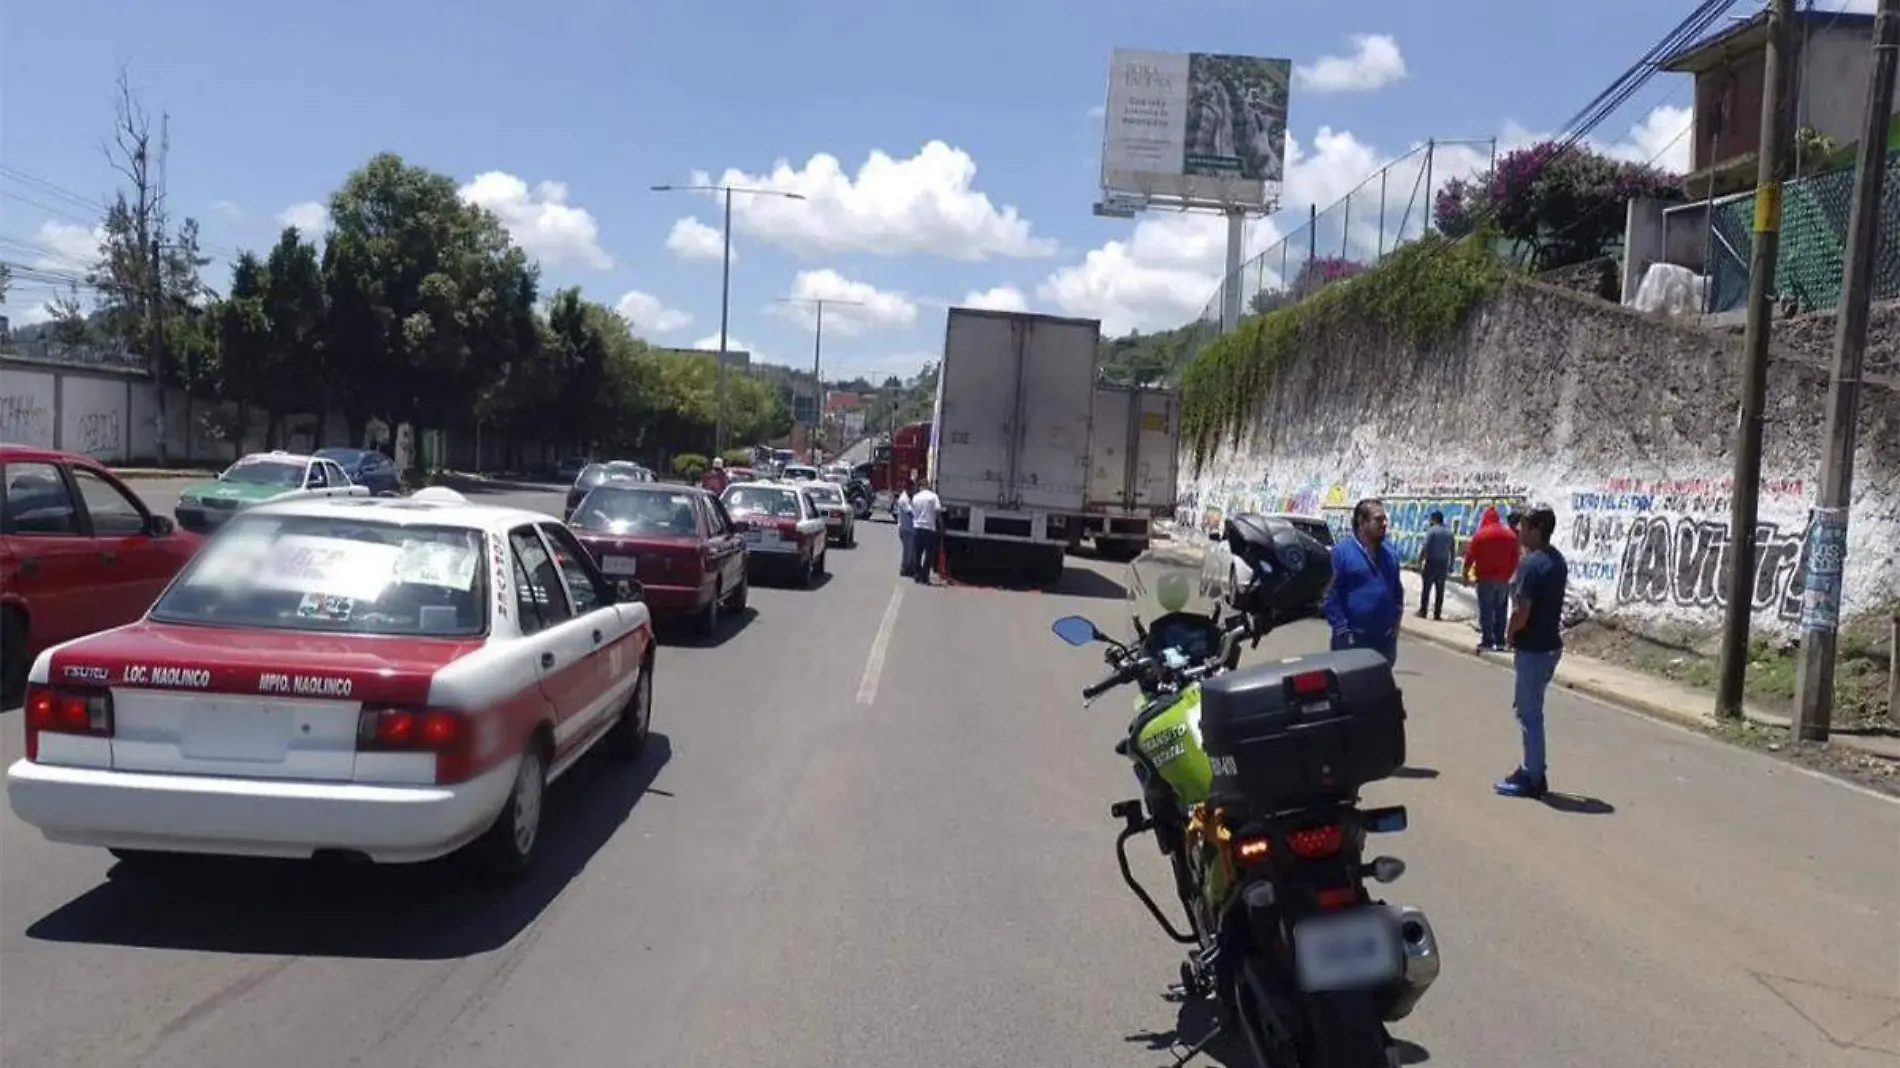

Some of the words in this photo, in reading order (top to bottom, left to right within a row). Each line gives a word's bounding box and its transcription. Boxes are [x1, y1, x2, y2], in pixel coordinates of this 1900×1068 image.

[123, 664, 149, 683] LOC.
[151, 665, 210, 687] NAOLINCO
[259, 671, 290, 693] MPIO.
[293, 674, 352, 696] NAOLINCO
